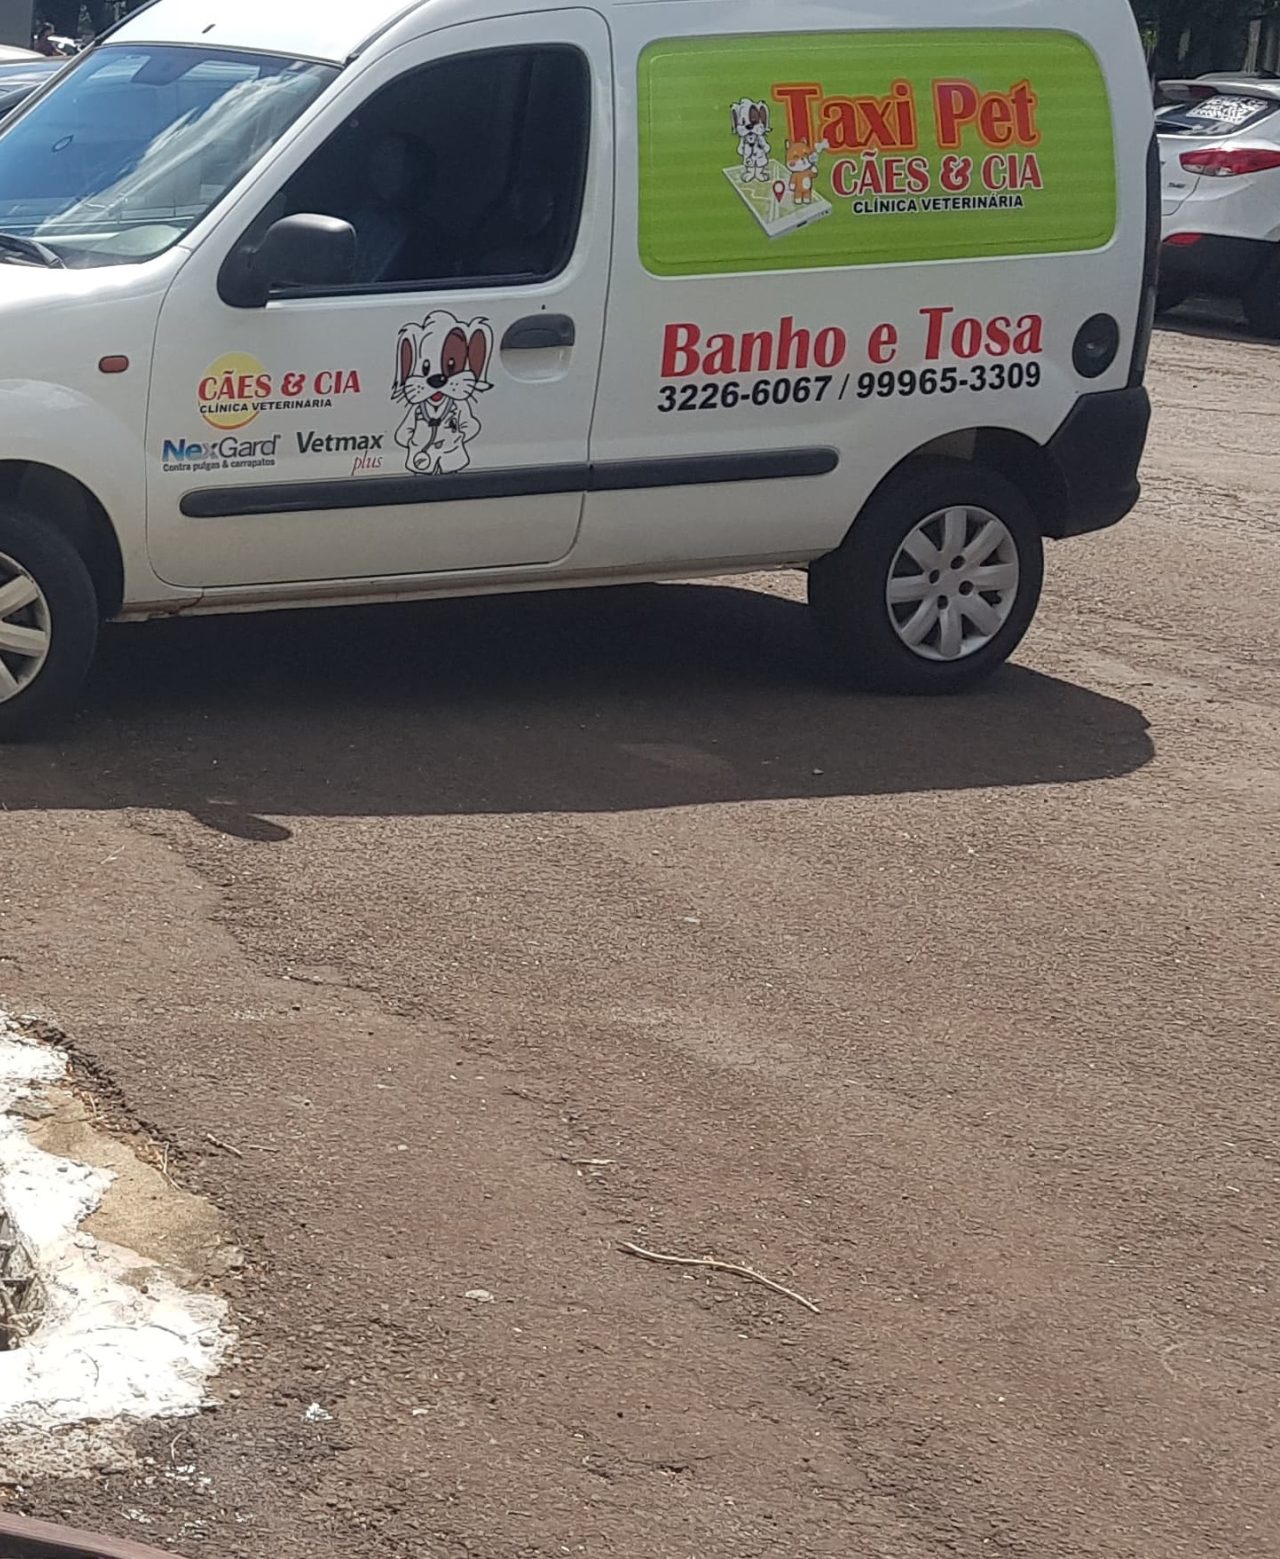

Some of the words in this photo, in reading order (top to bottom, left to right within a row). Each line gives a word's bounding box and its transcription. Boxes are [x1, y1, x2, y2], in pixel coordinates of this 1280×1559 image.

[773, 79, 916, 150] Taxi
[933, 79, 1041, 149] Pet
[832, 150, 930, 196] CÃES
[940, 155, 972, 192] &
[981, 153, 1043, 191] CIA
[853, 198, 917, 214] CLÍNICA
[921, 193, 1024, 212] VETERINÁRIA
[660, 316, 846, 378] Banho
[868, 323, 898, 364] e
[919, 307, 1043, 360] Tosa
[198, 370, 272, 401] CÃES
[281, 372, 306, 397] &
[314, 370, 361, 395] CIA
[657, 375, 833, 412] 3226-6067
[838, 373, 850, 400] /
[856, 361, 1041, 398] 99965-3309
[200, 402, 249, 414] CLÍNICA
[162, 434, 278, 461] NexGard
[296, 431, 384, 454] Vetmax
[163, 463, 191, 472] Contra
[351, 450, 383, 477] plus
